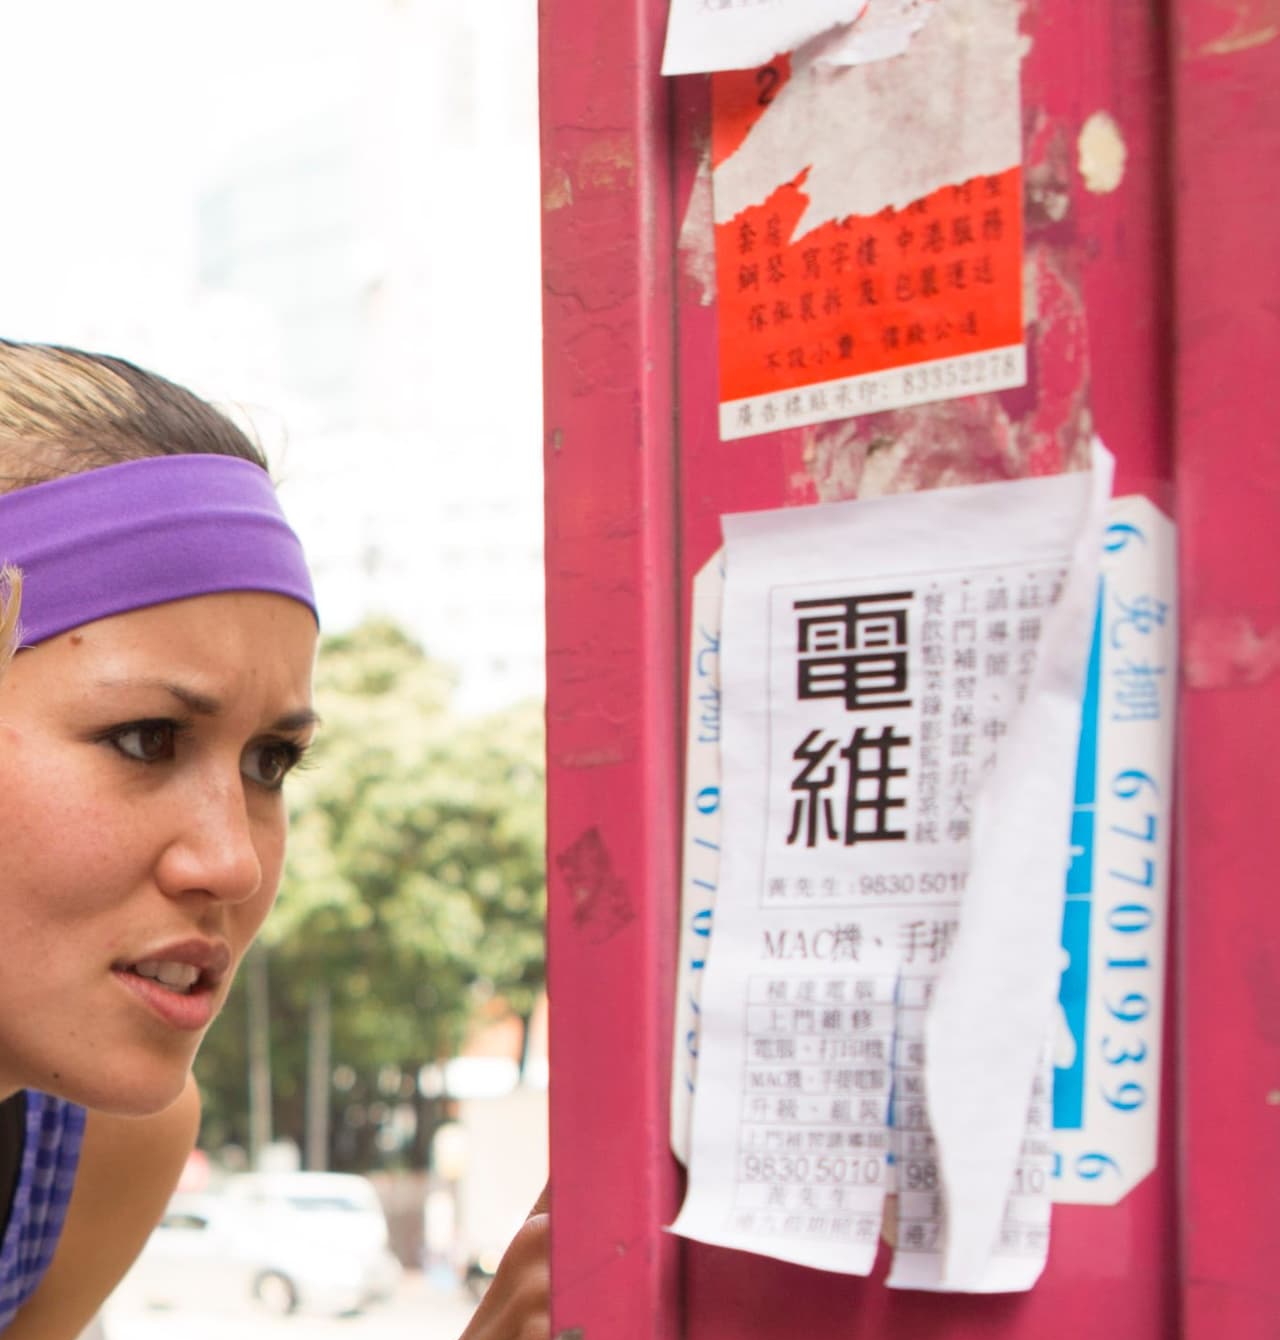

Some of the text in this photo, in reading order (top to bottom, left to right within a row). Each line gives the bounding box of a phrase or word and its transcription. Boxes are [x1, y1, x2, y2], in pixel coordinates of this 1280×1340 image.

[859, 873, 914, 895] 9830
[1099, 767, 1159, 1112] 67701939
[769, 1008, 872, 1031] 上門維修
[745, 1156, 880, 1184] 9830 5010
